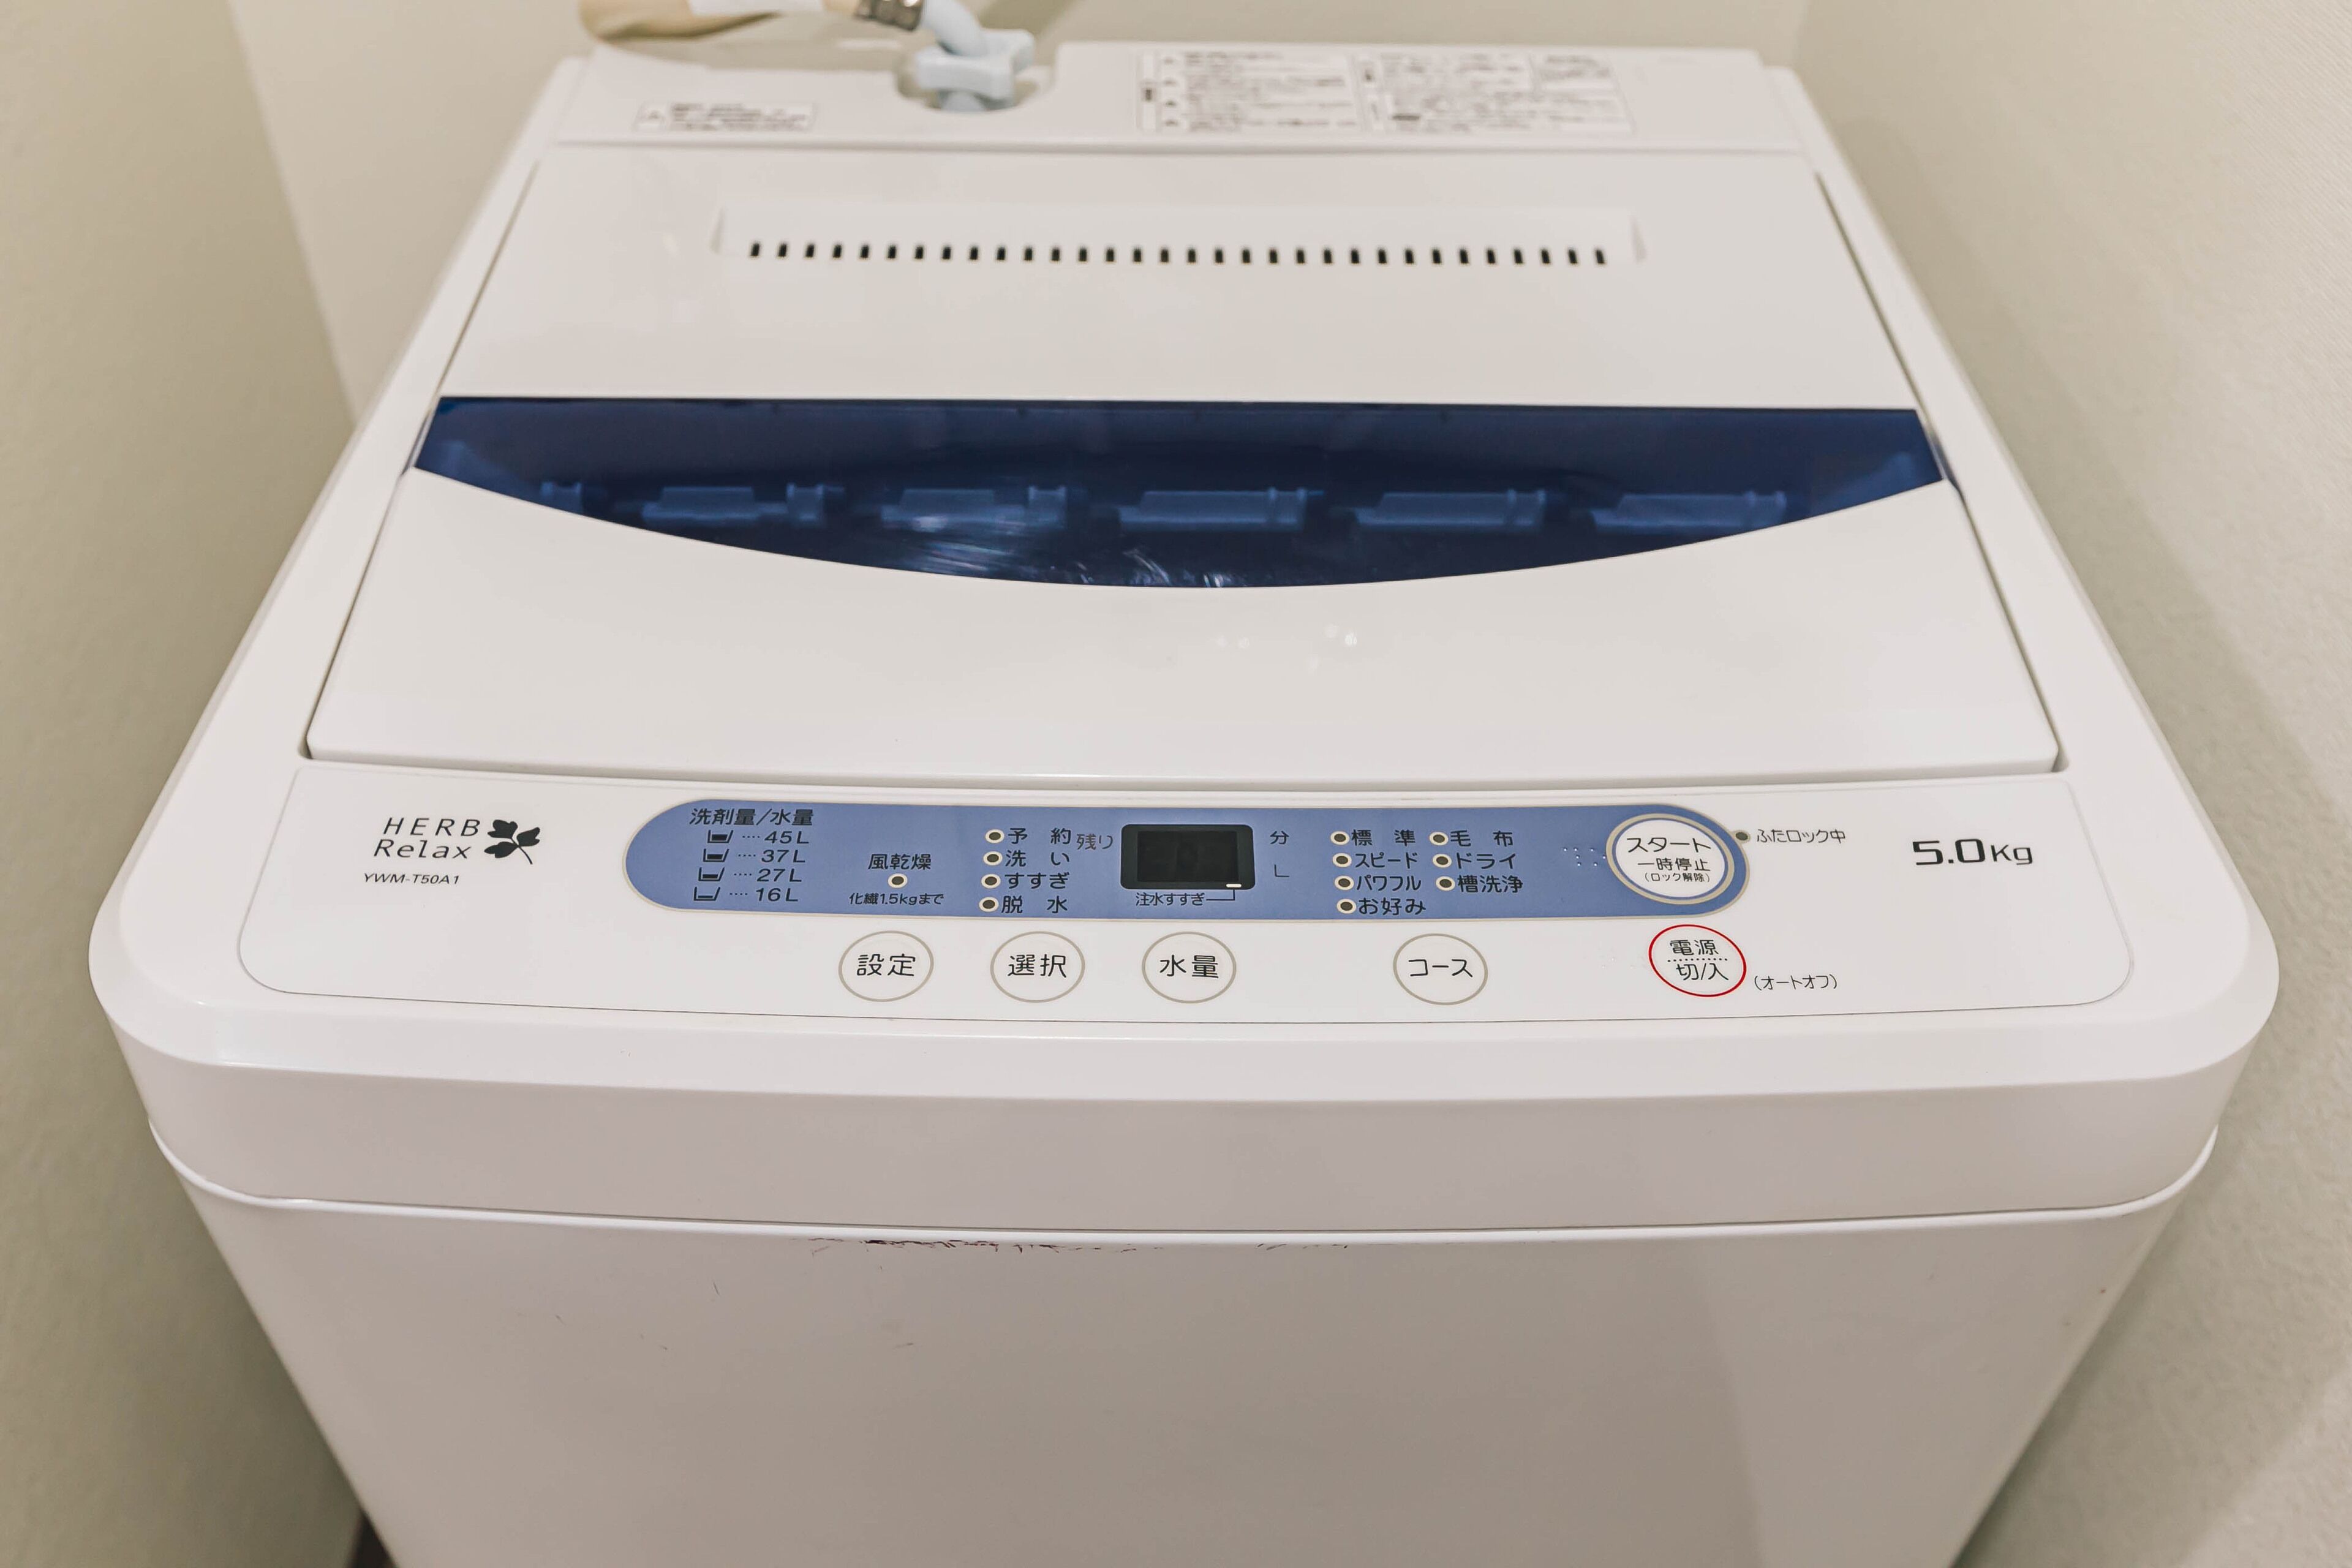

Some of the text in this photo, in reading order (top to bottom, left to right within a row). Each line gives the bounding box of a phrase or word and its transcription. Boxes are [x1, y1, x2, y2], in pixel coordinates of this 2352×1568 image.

[689, 808, 814, 826] 洗剤量/水量
[383, 817, 480, 837] HERB
[1076, 833, 1114, 851] 残り
[1270, 830, 1289, 845] 分
[1626, 835, 1714, 853] スタート
[1757, 829, 1846, 844] ふたロック中
[374, 839, 471, 859] Relax
[867, 853, 932, 870] 風乾燥
[1355, 851, 1418, 869] スピード
[1456, 852, 1516, 870] ドライ
[1637, 857, 1711, 872] 一時停止
[364, 873, 459, 884] YWM-T50A1
[1004, 872, 1070, 889] すすぎ
[1356, 874, 1422, 892] パワフル
[1457, 874, 1523, 894] 槽洗浄
[1136, 892, 1205, 907] 注水すすぎ
[1358, 897, 1427, 916] お好み
[1670, 939, 1719, 956] 電源
[856, 953, 916, 977] 設定
[1007, 954, 1067, 978] 選択
[1159, 954, 1219, 979] 水量
[1408, 959, 1473, 978] コース
[1675, 962, 1729, 981] 切/入
